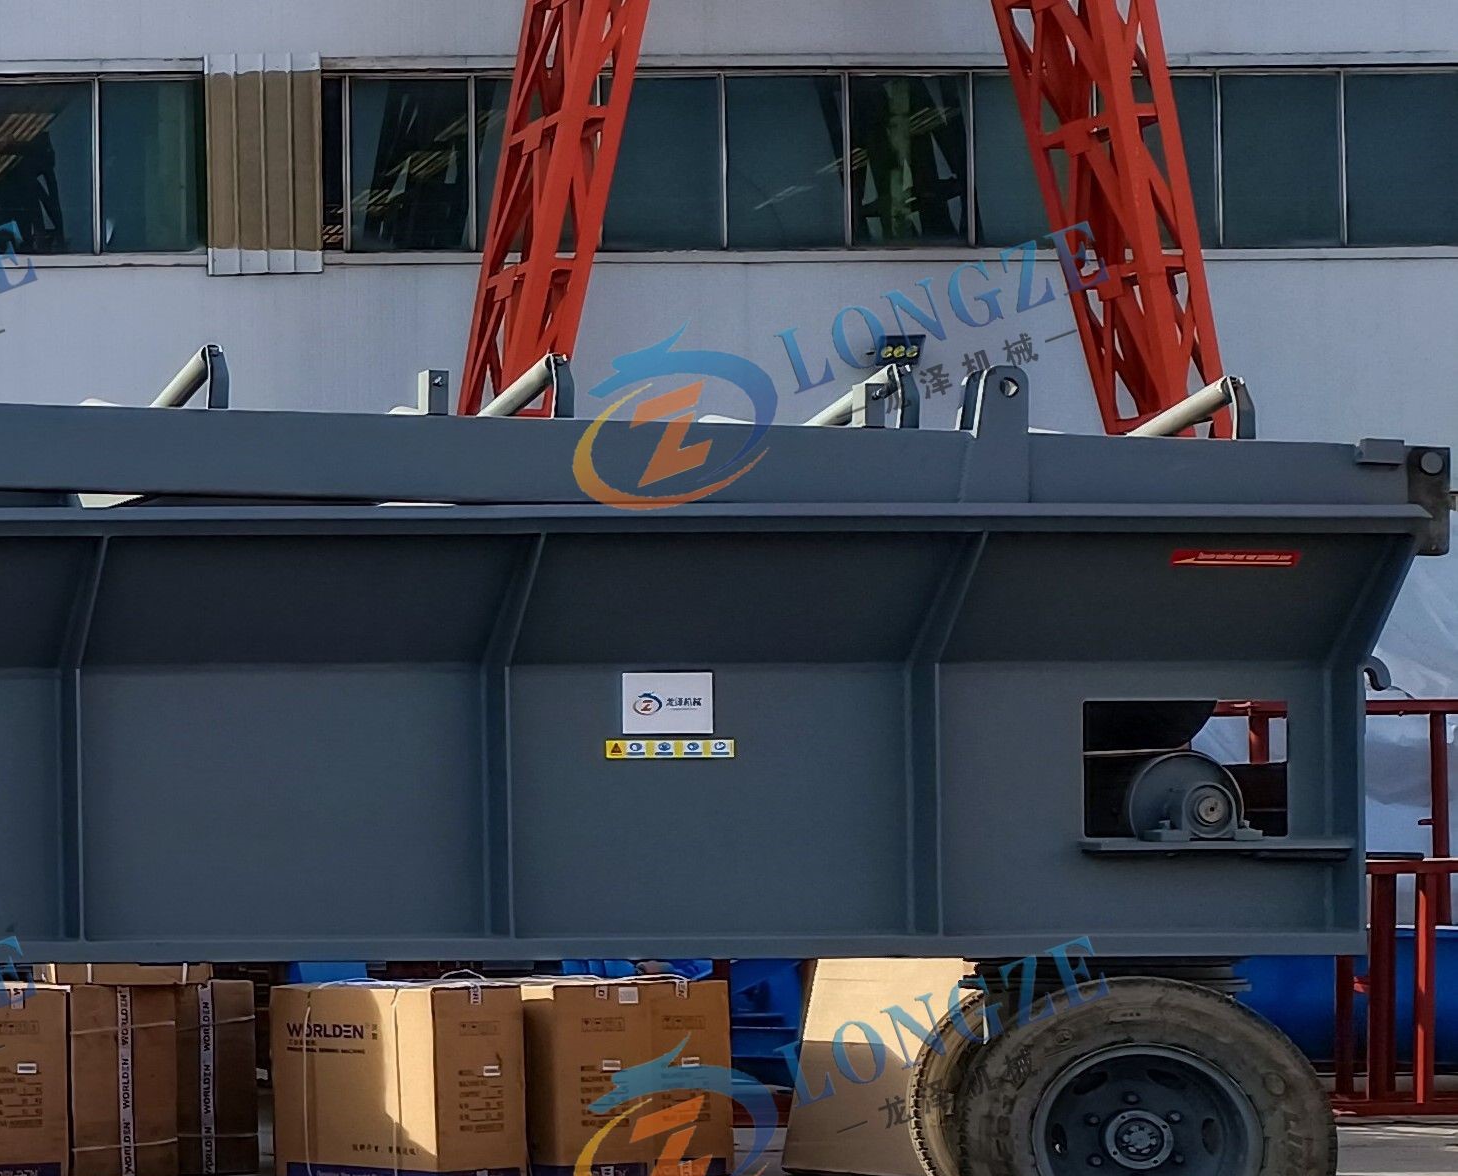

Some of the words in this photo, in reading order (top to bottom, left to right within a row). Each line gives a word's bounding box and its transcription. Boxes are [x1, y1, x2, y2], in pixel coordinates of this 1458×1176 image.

[121, 993, 129, 1045] WORLDEN
[202, 1001, 211, 1052] WORLDEN
[286, 1022, 364, 1039] WORLDEN
[122, 1058, 130, 1109] WORLDEN
[203, 1064, 211, 1114] WORLDEN
